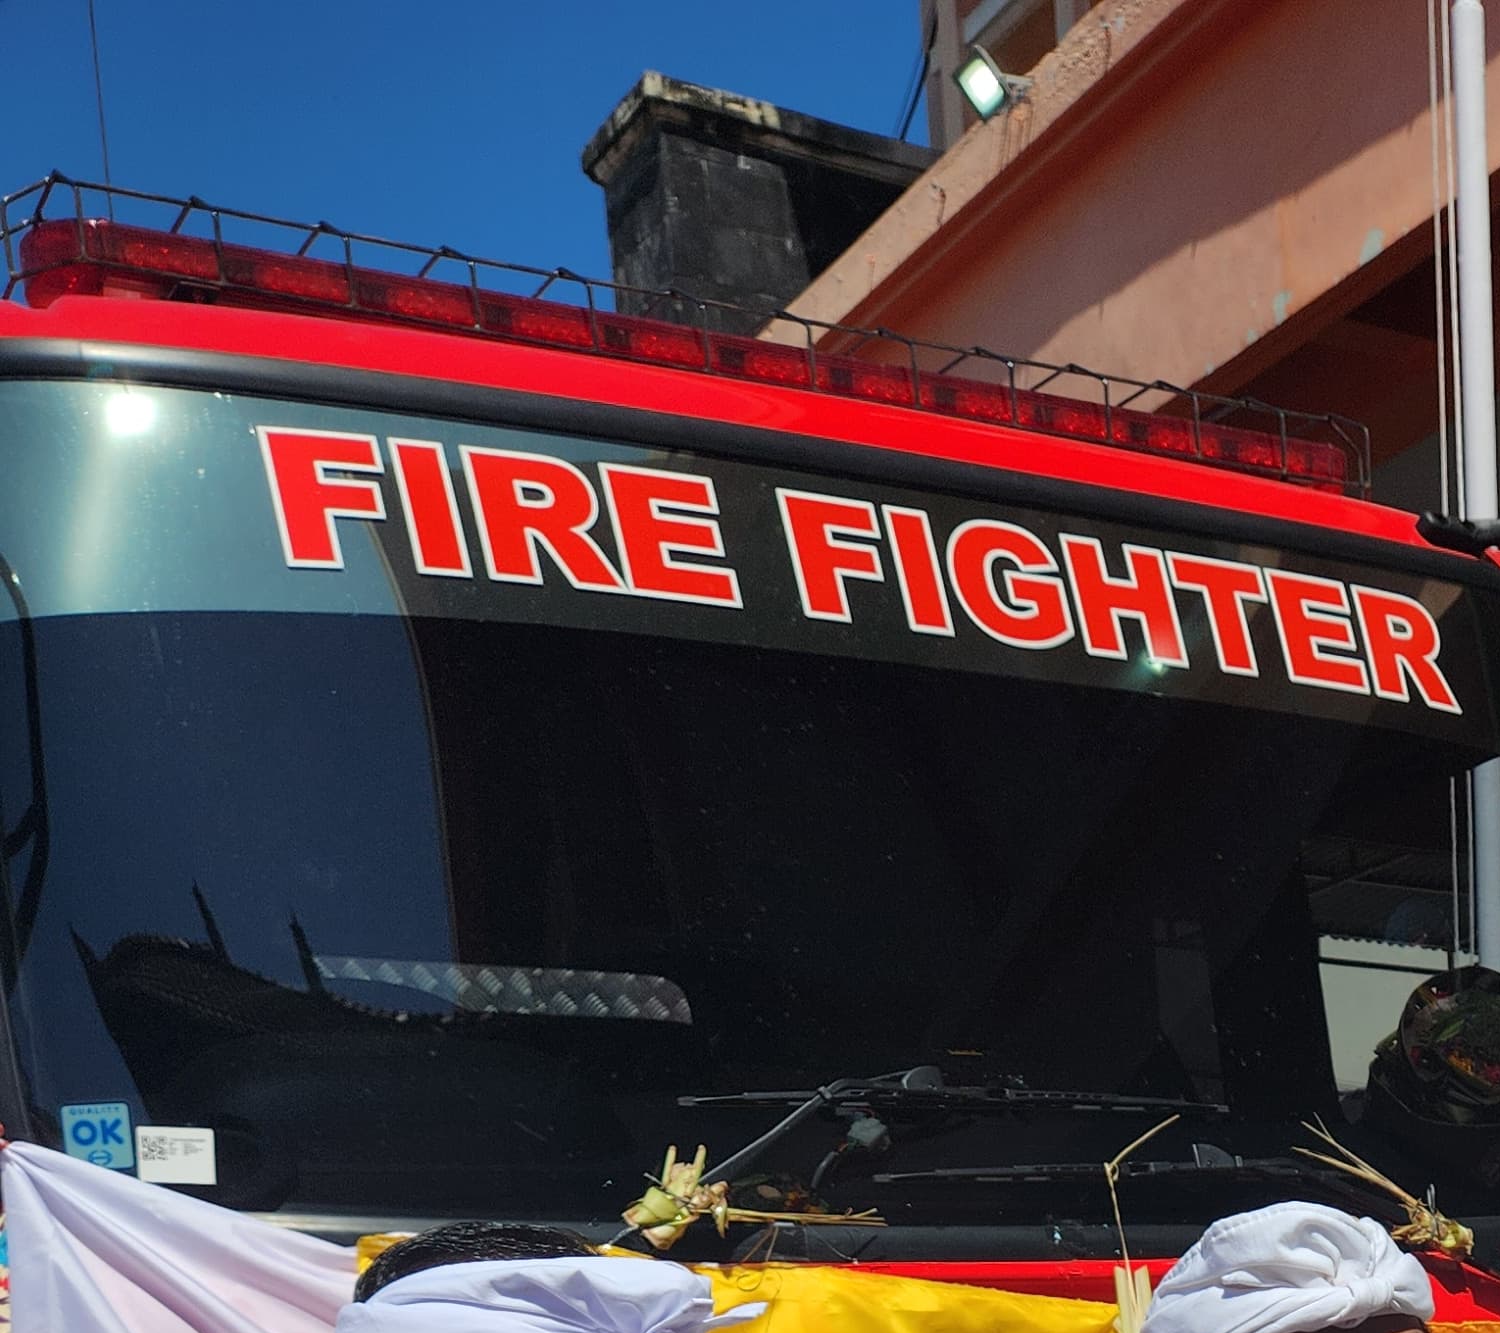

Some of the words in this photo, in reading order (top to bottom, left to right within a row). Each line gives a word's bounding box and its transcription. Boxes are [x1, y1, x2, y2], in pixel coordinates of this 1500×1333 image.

[256, 424, 744, 610] FIRE
[774, 486, 1463, 716] FIGHTER
[72, 1118, 124, 1147] OK
